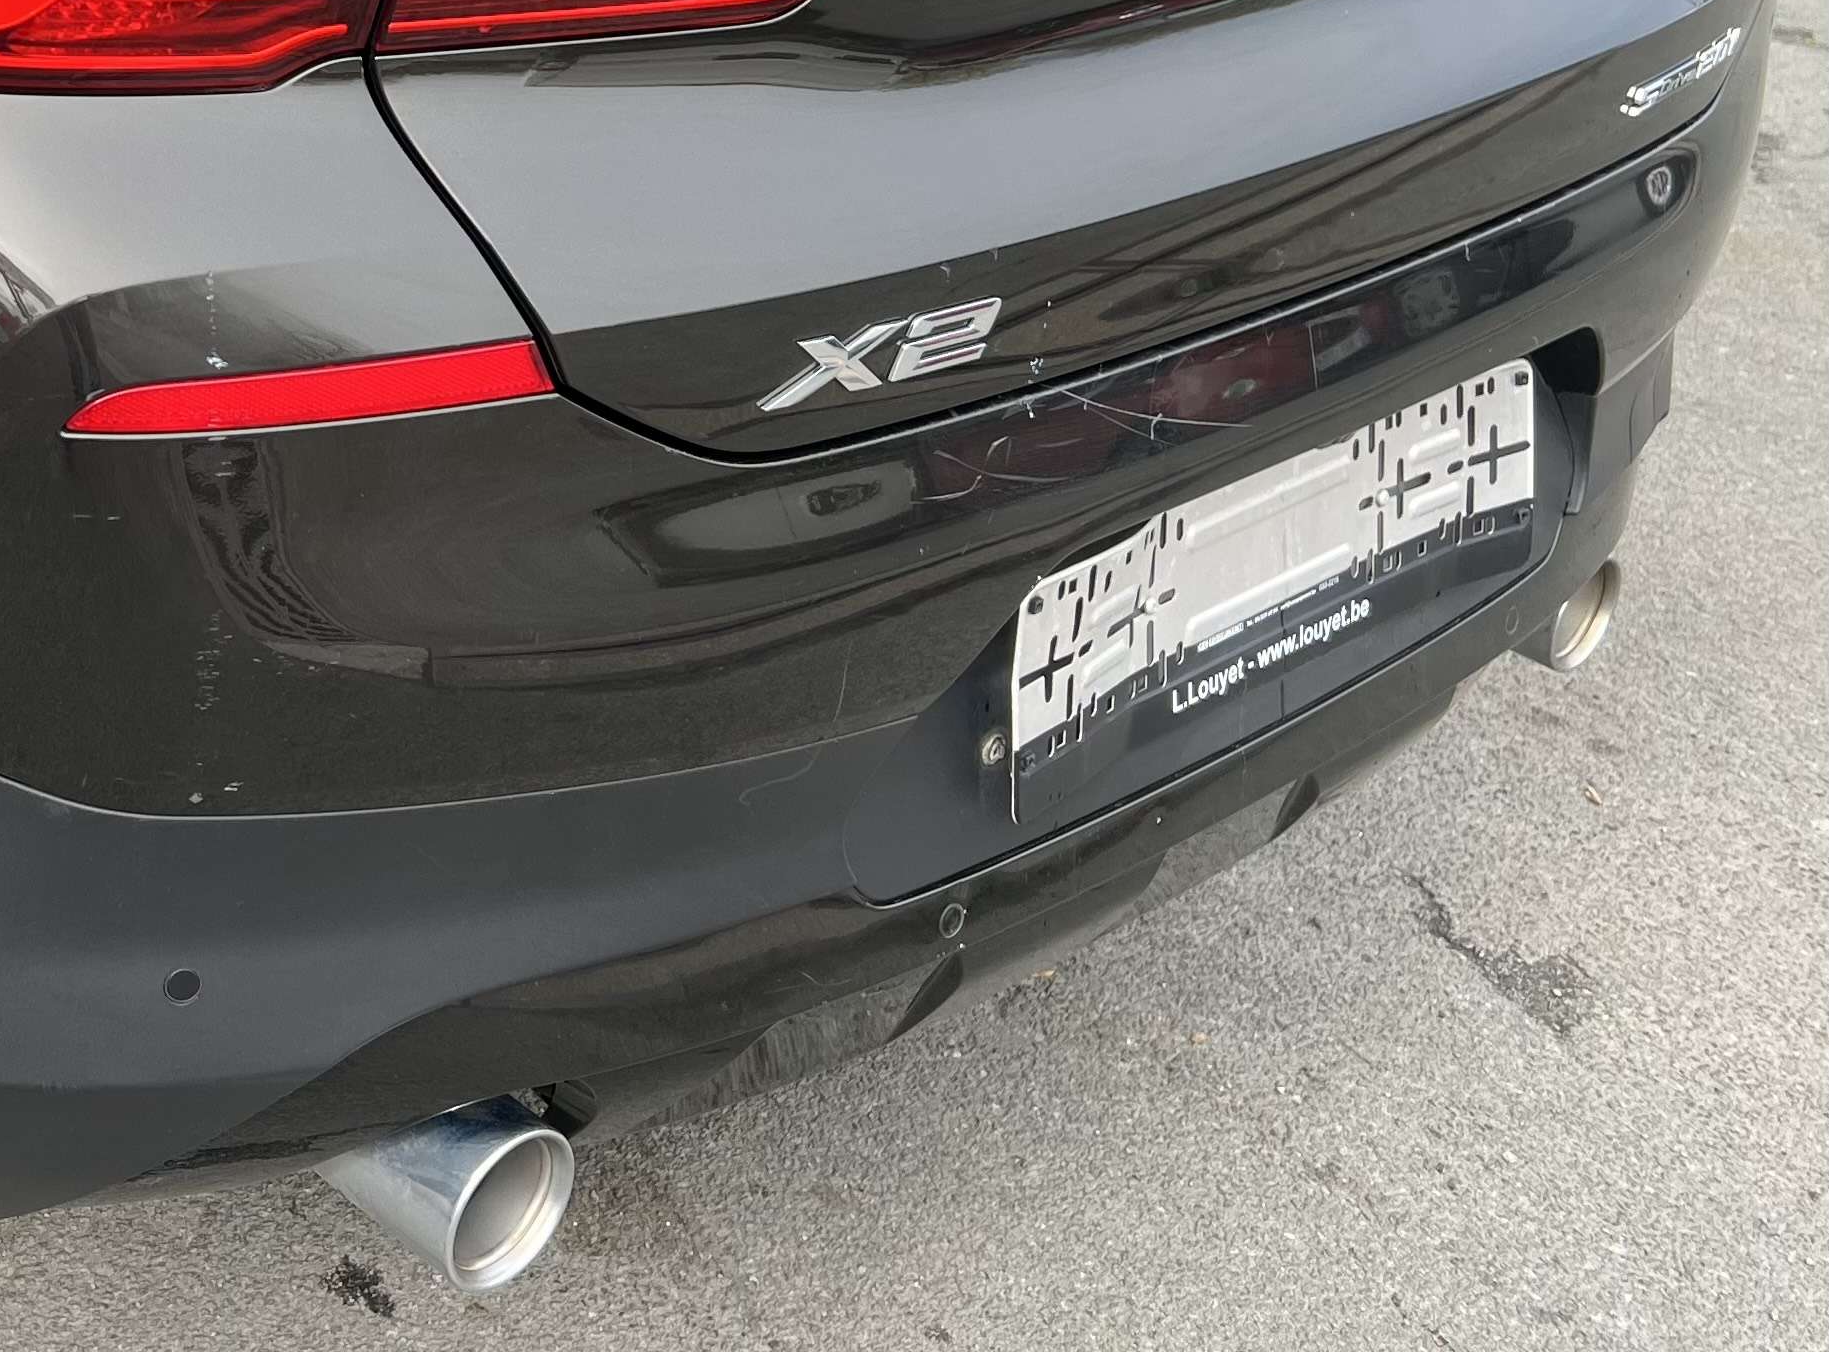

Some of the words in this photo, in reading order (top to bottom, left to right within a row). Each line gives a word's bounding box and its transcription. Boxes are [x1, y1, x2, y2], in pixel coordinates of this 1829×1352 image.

[756, 296, 1003, 411] X2
[1172, 656, 1245, 714] L.Louyet
[1256, 596, 1371, 670] www.louyet.be
